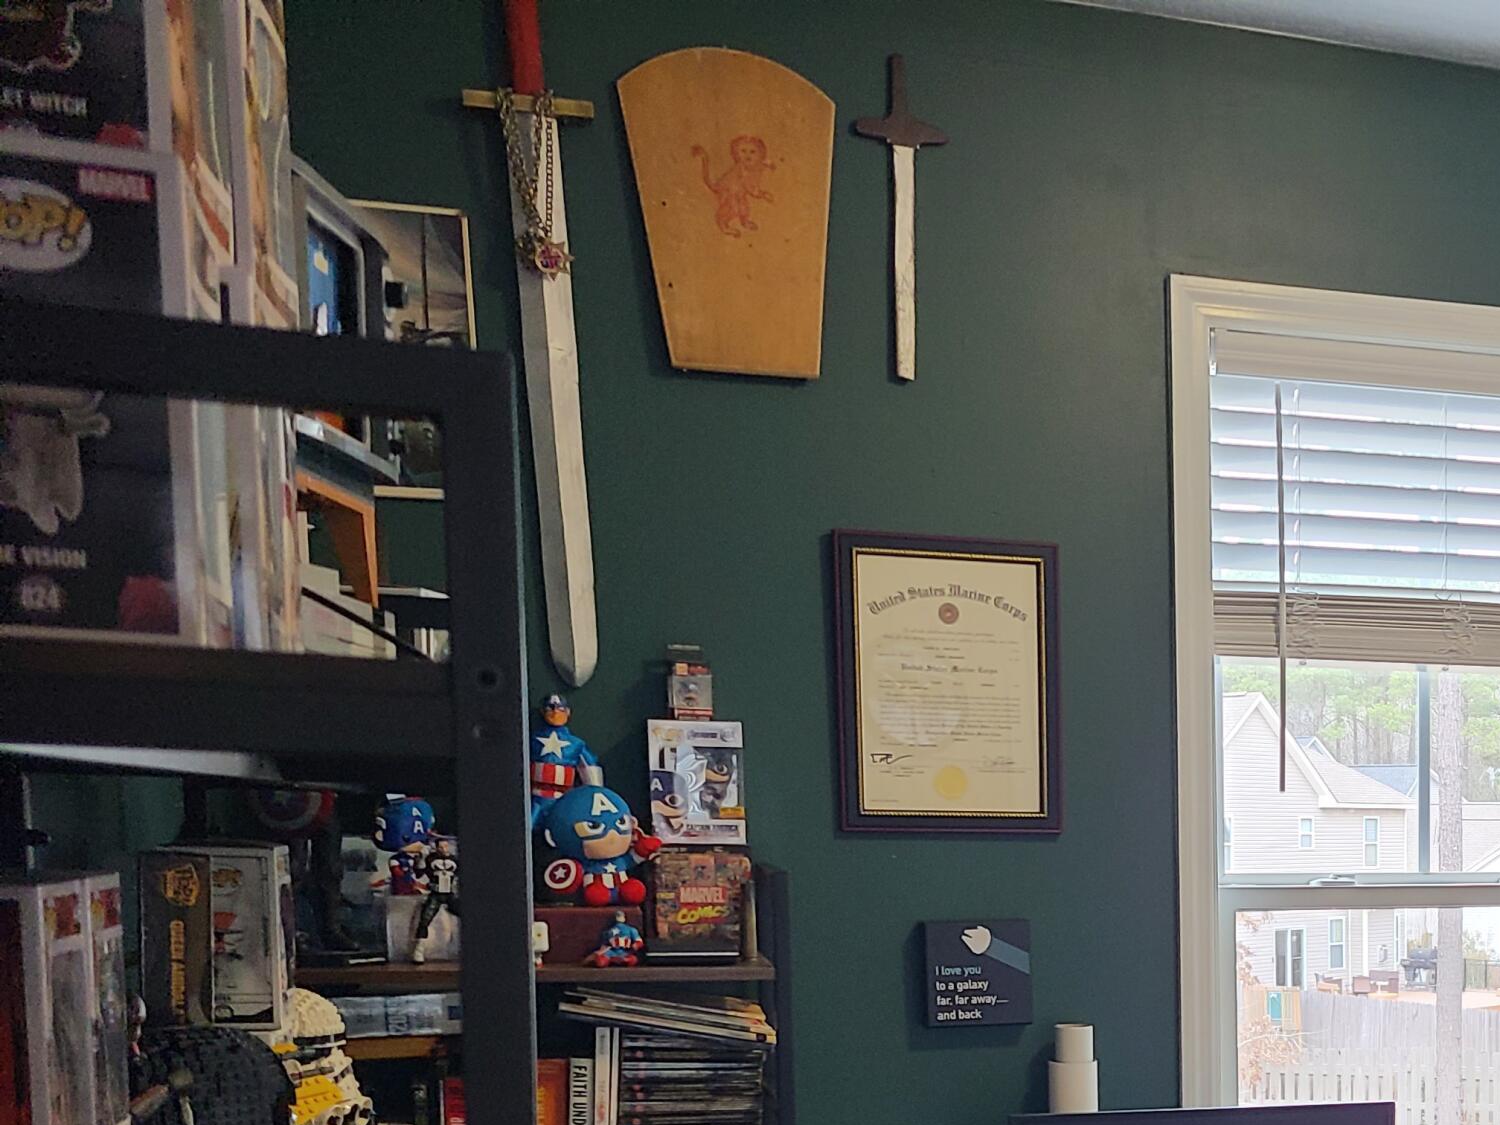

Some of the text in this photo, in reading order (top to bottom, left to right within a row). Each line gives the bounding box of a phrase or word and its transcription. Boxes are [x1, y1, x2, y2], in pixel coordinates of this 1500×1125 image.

[867, 584, 1028, 622] United States Marine Corps
[591, 792, 619, 816] A
[680, 886, 726, 904] MARVEL
[676, 905, 730, 925] COMICS
[941, 966, 962, 976] love
[964, 966, 982, 977] you
[935, 981, 946, 991] to
[957, 980, 989, 992] galaxy
[955, 995, 969, 1005] far
[937, 1009, 982, 1021] and back
[572, 1065, 588, 1098] FAITH
